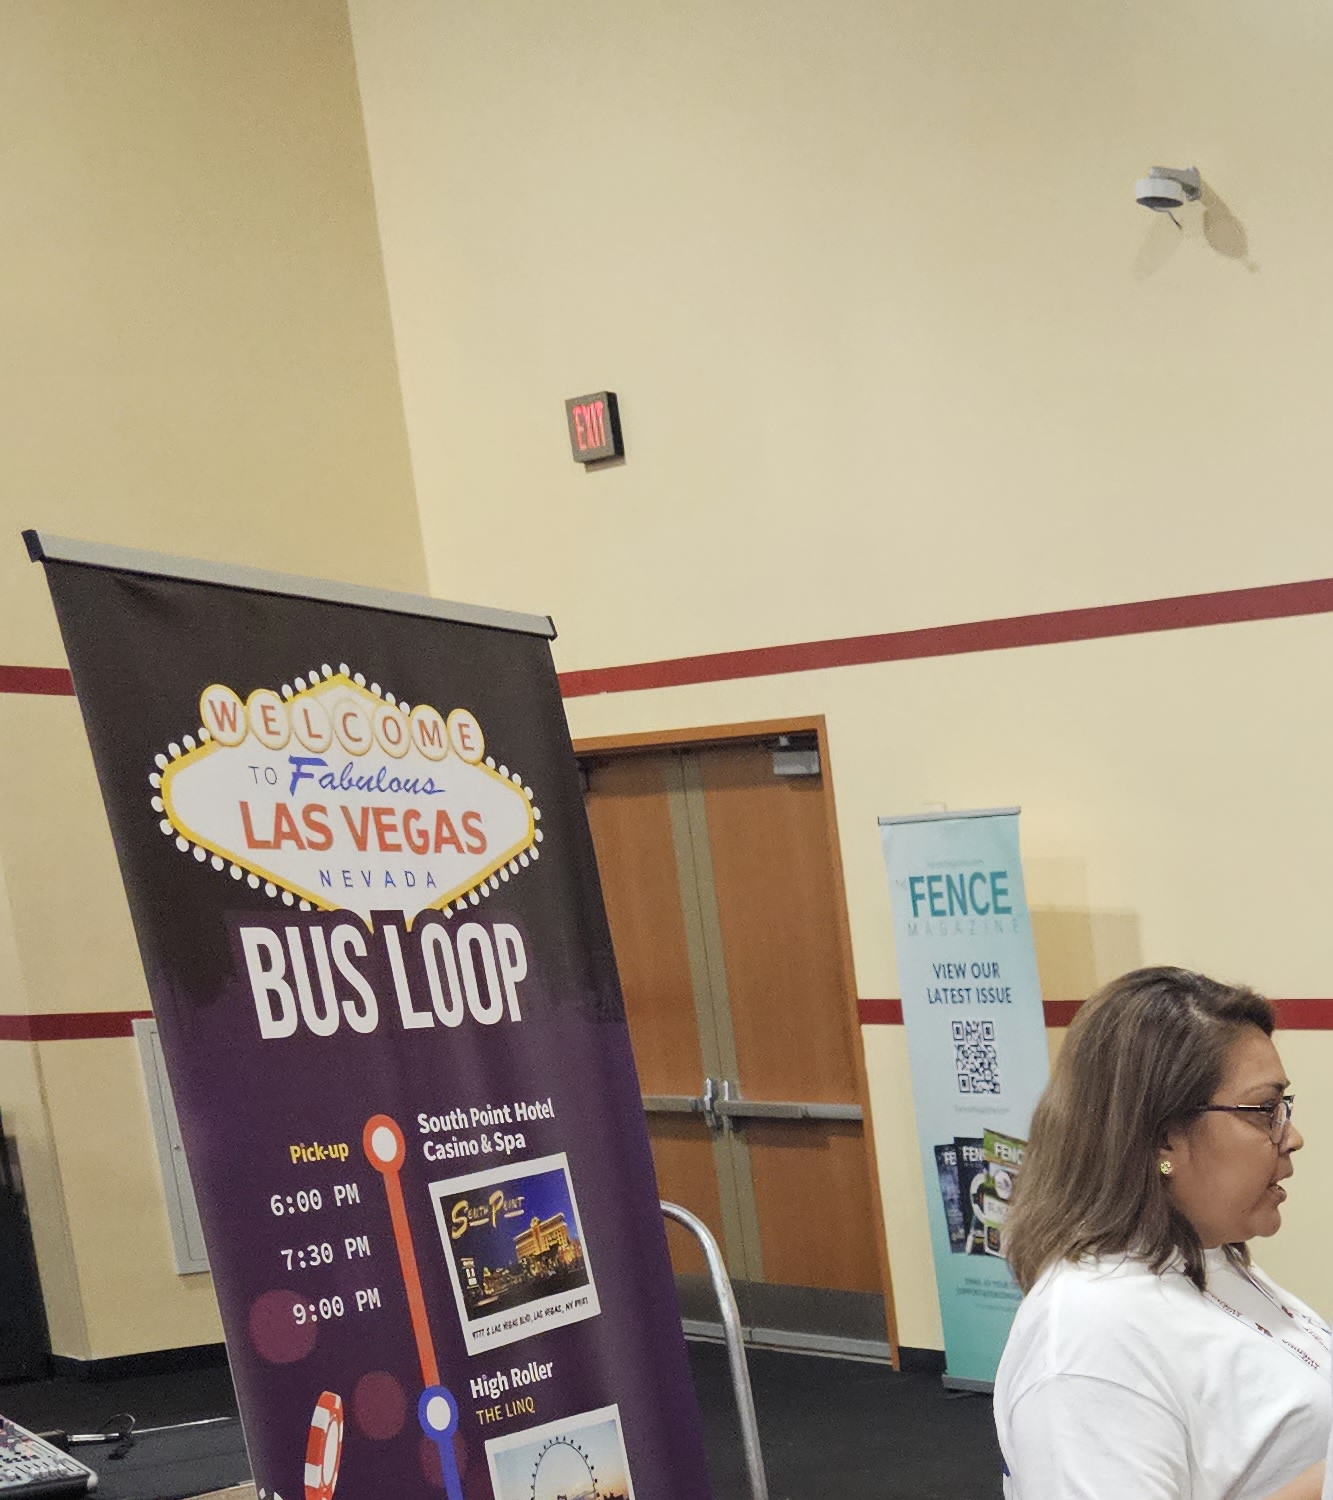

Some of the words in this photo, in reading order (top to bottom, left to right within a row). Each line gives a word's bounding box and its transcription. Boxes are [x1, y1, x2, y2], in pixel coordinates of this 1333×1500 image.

[573, 401, 605, 451] EXIT
[208, 700, 475, 751] WELCOME
[248, 765, 278, 785] TO
[288, 755, 446, 797] Fabulous
[239, 801, 334, 850] LAS
[340, 805, 487, 855] VEGAS
[319, 869, 437, 888] NEVADA
[909, 871, 1013, 918] FENCE
[907, 918, 1020, 937] MAGAZINE
[240, 923, 379, 1040] BUS
[383, 922, 528, 1030] LOOP
[932, 963, 967, 980] VIEW
[971, 962, 1001, 979] OUR
[927, 988, 972, 1004] LATEST
[976, 987, 1012, 1004] ISSUE
[417, 1108, 469, 1134] South
[469, 1104, 512, 1127] Point
[514, 1098, 555, 1122] Hotel
[290, 1142, 349, 1164] Pick-up
[423, 1137, 478, 1161] Casino
[481, 1134, 493, 1154] &
[493, 1132, 526, 1155] Spa
[270, 1188, 322, 1216] 6:00
[334, 1183, 360, 1206] PM
[281, 1243, 333, 1271] 7:30
[345, 1236, 371, 1259] PM
[293, 1295, 344, 1325] 9:00
[355, 1287, 381, 1312] PM
[470, 1371, 509, 1399] High
[510, 1361, 553, 1388] Roller
[476, 1405, 503, 1426] THE
[505, 1396, 536, 1417] LINQ
